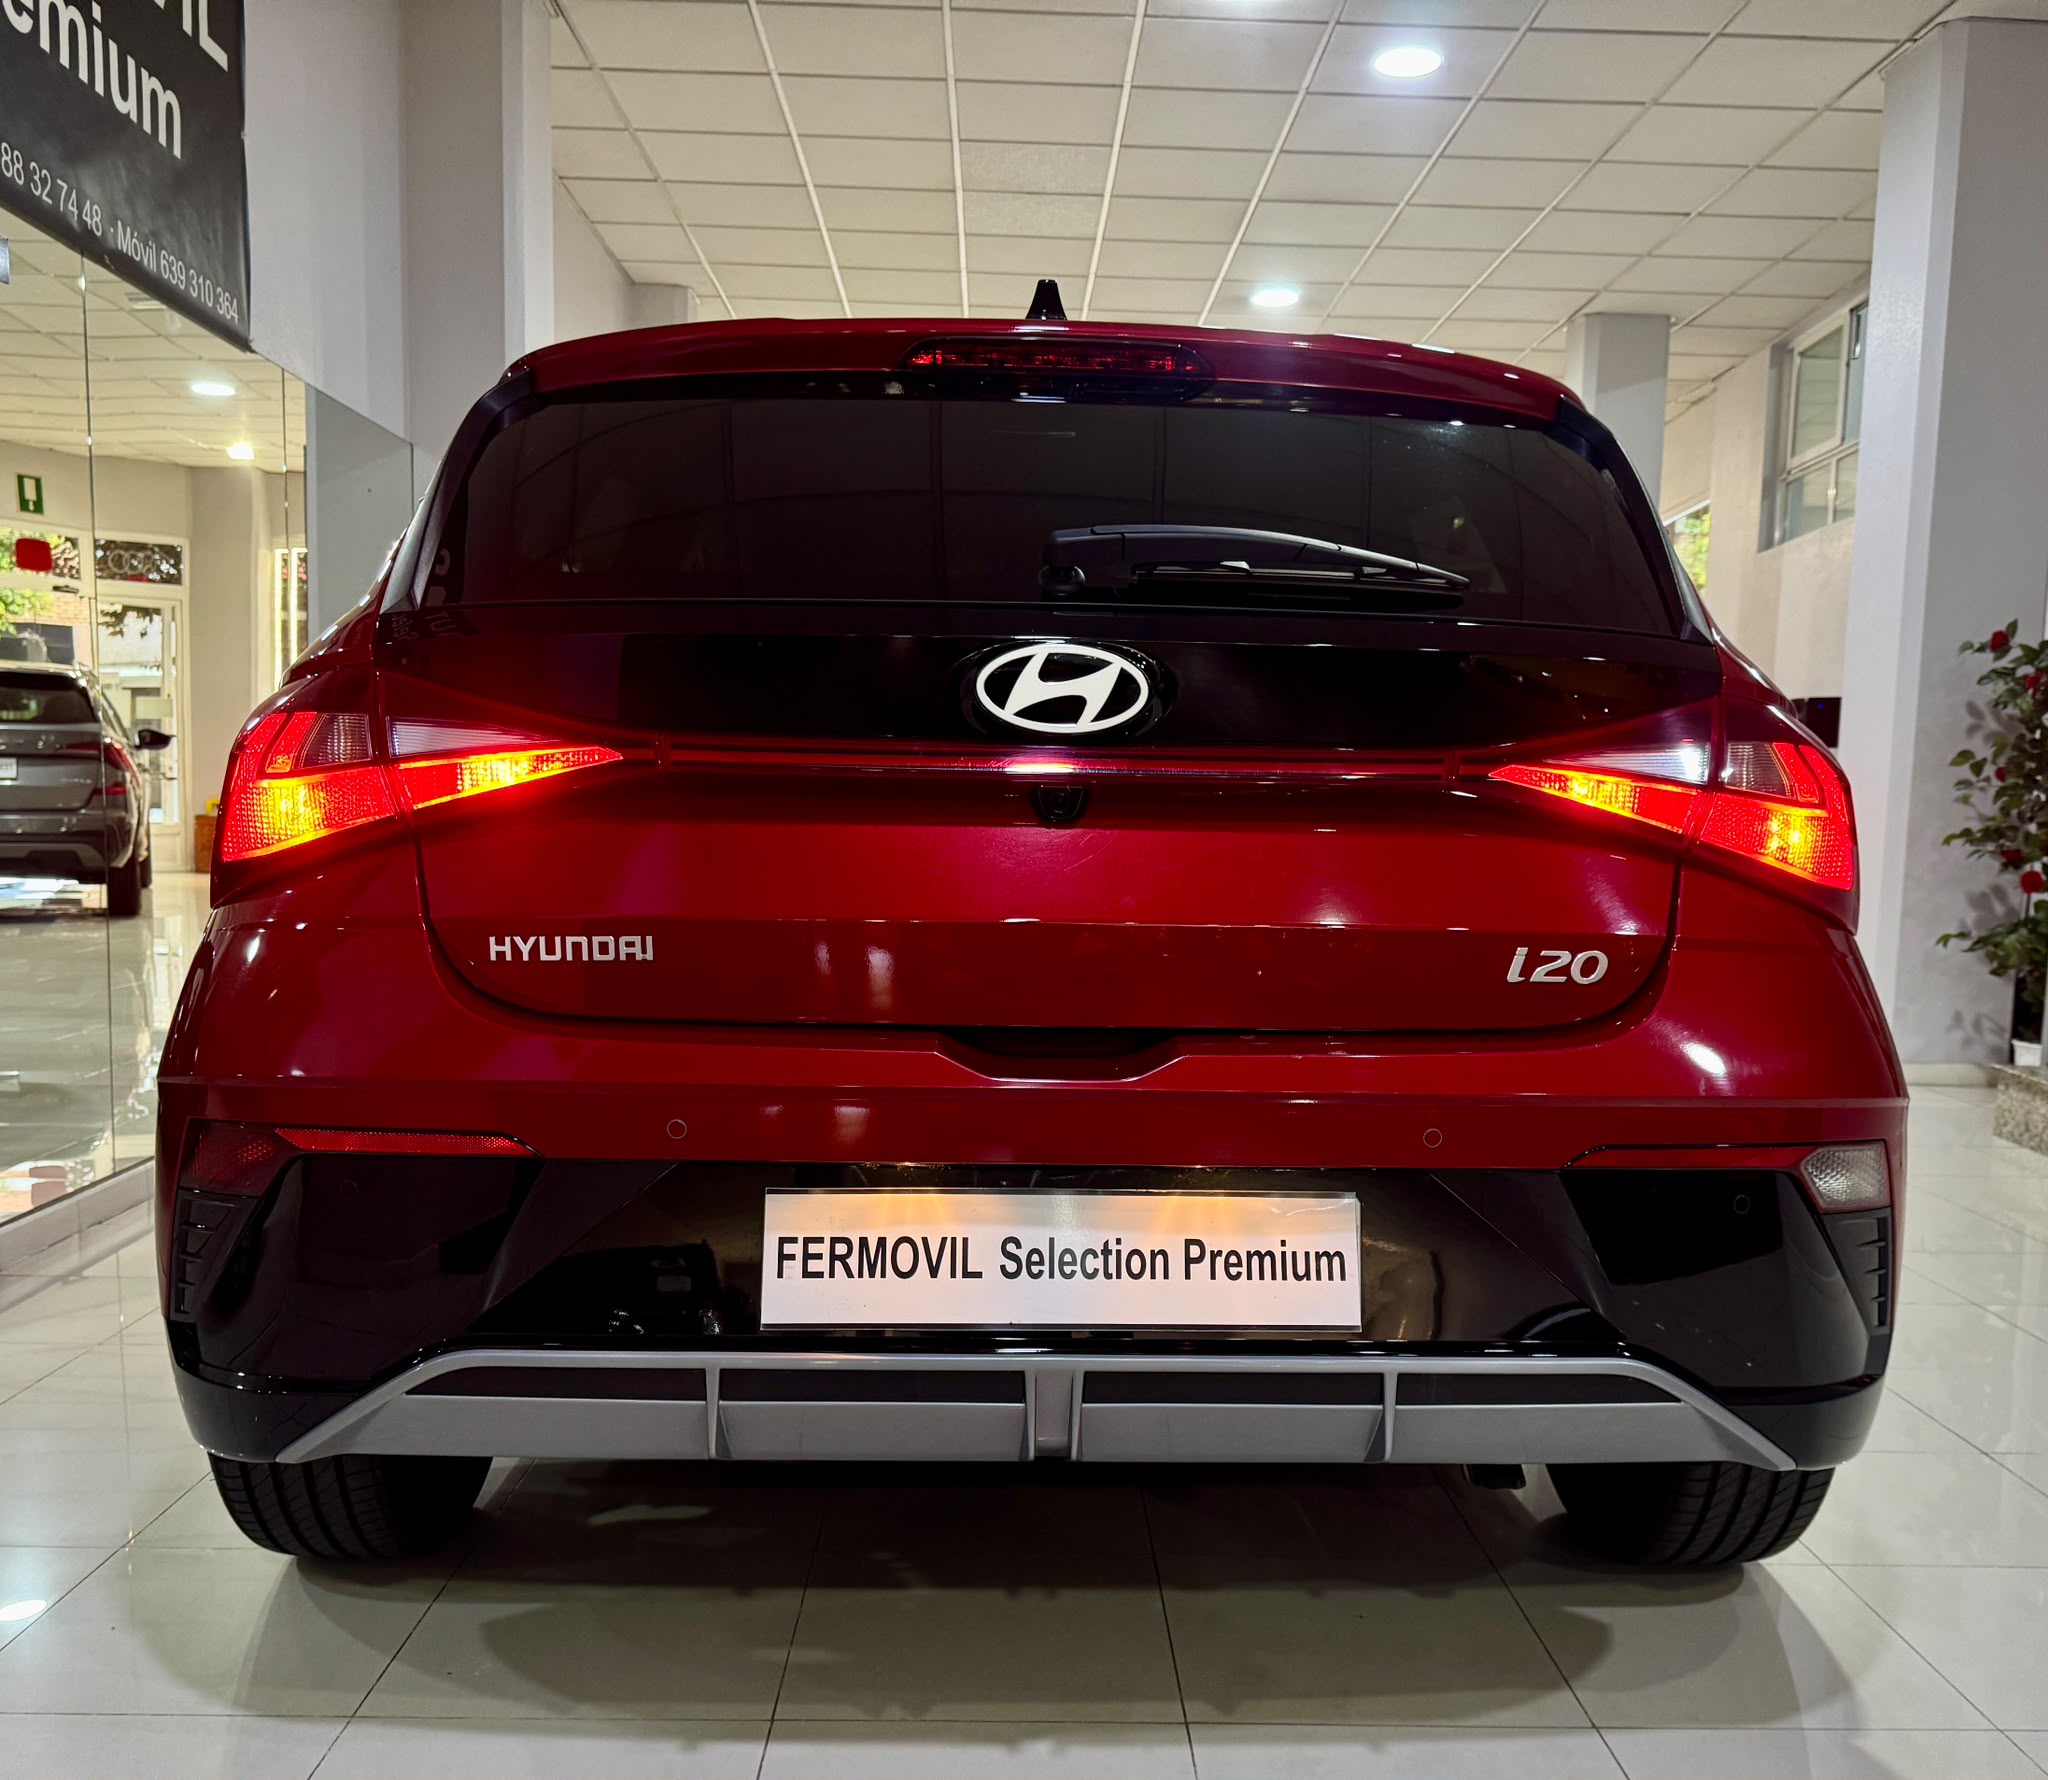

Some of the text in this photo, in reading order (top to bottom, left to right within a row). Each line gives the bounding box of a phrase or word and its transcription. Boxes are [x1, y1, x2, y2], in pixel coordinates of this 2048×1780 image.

[29, 161, 52, 205] 32
[56, 178, 78, 221] 74
[82, 199, 102, 237] 48
[117, 220, 157, 272] Móvil
[160, 249, 185, 290] 639
[189, 268, 213, 307] 310
[216, 287, 238, 325] 364
[489, 935, 654, 962] HYUNDAI
[1506, 946, 1609, 985] i20
[776, 1235, 1347, 1282] FERMOVIL Selection Premium
